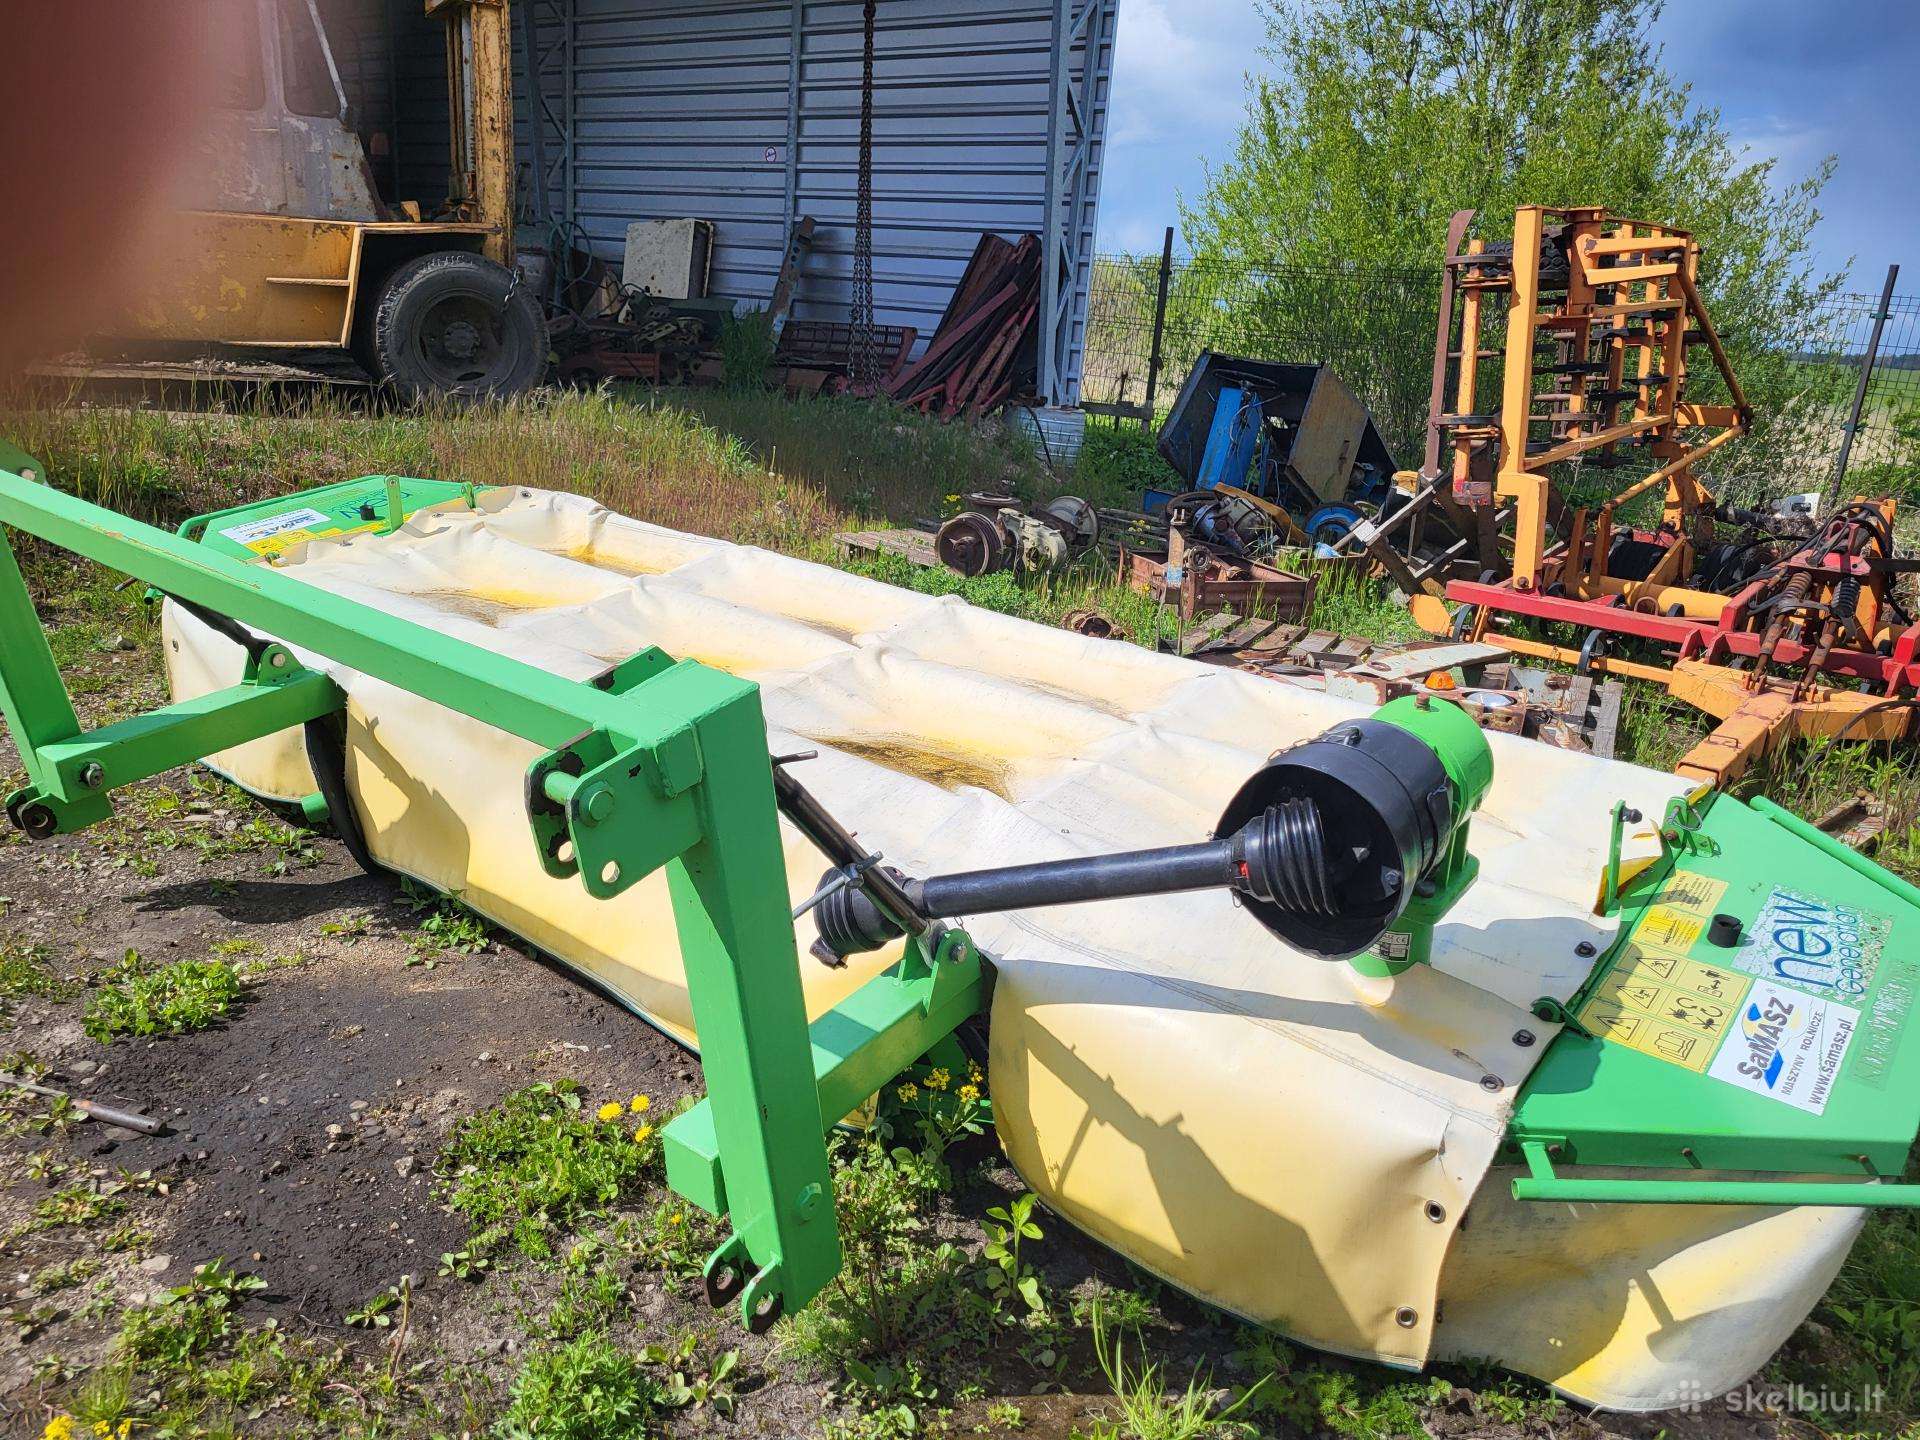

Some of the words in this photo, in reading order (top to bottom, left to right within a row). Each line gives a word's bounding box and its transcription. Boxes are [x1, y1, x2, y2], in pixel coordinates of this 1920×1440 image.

[1773, 892, 1834, 988] new
[1737, 996, 1795, 1080] SaMASZ
[1781, 1054, 1806, 1096] MASZYNY
[1800, 1011, 1824, 1051] ROLNICZE
[1808, 1017, 1856, 1106] www.samasz.pl
